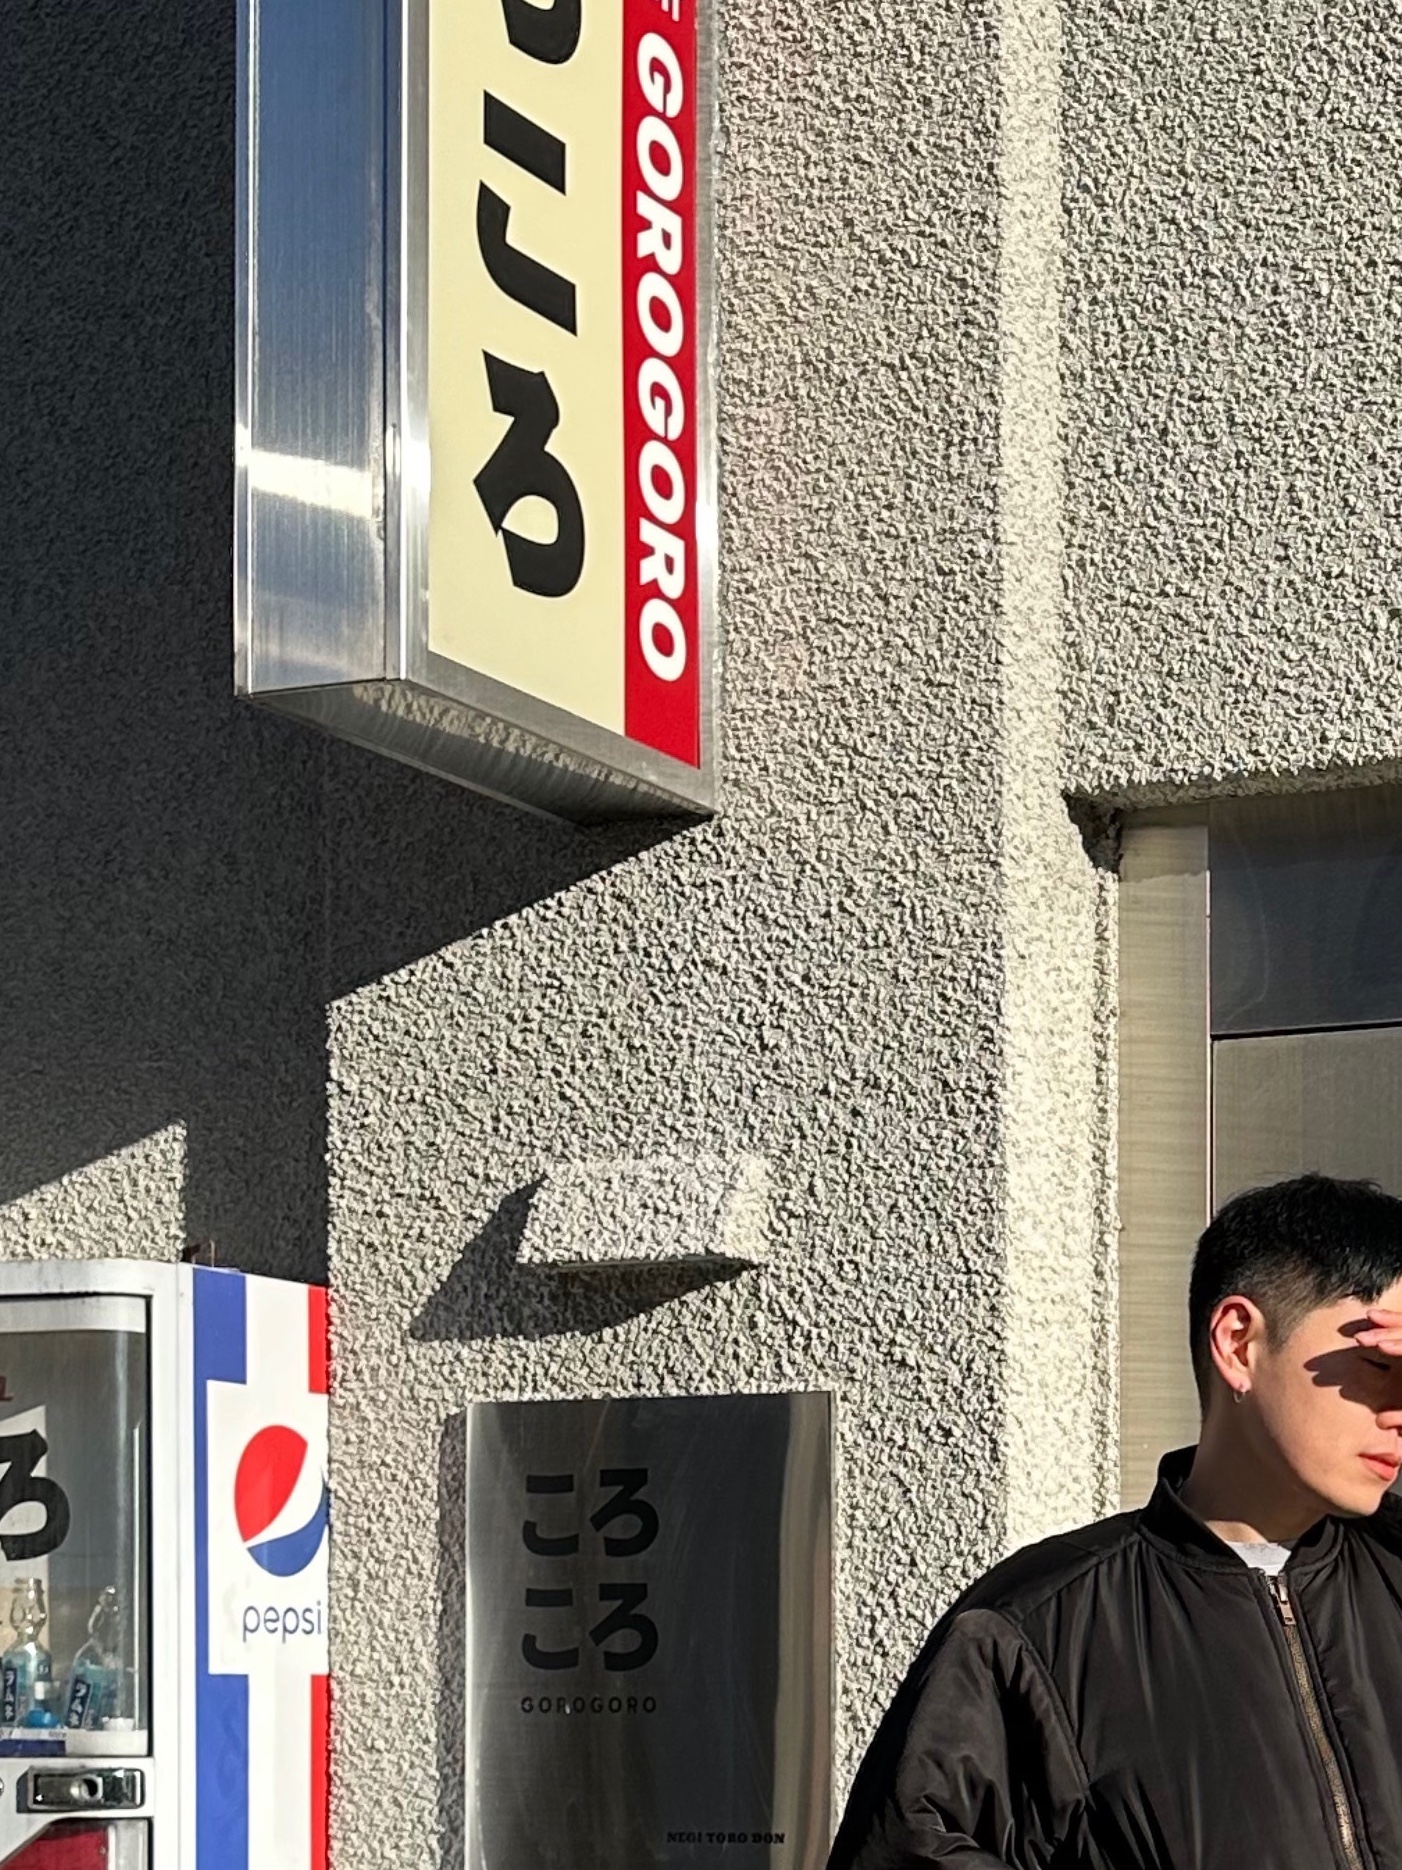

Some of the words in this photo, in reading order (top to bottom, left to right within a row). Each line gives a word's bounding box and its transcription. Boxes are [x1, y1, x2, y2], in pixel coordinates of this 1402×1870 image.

[637, 32, 685, 683] GOROGORO
[242, 1600, 322, 1644] pepsi
[521, 1696, 657, 1714] GOROGORO
[751, 1833, 786, 1844] DON
